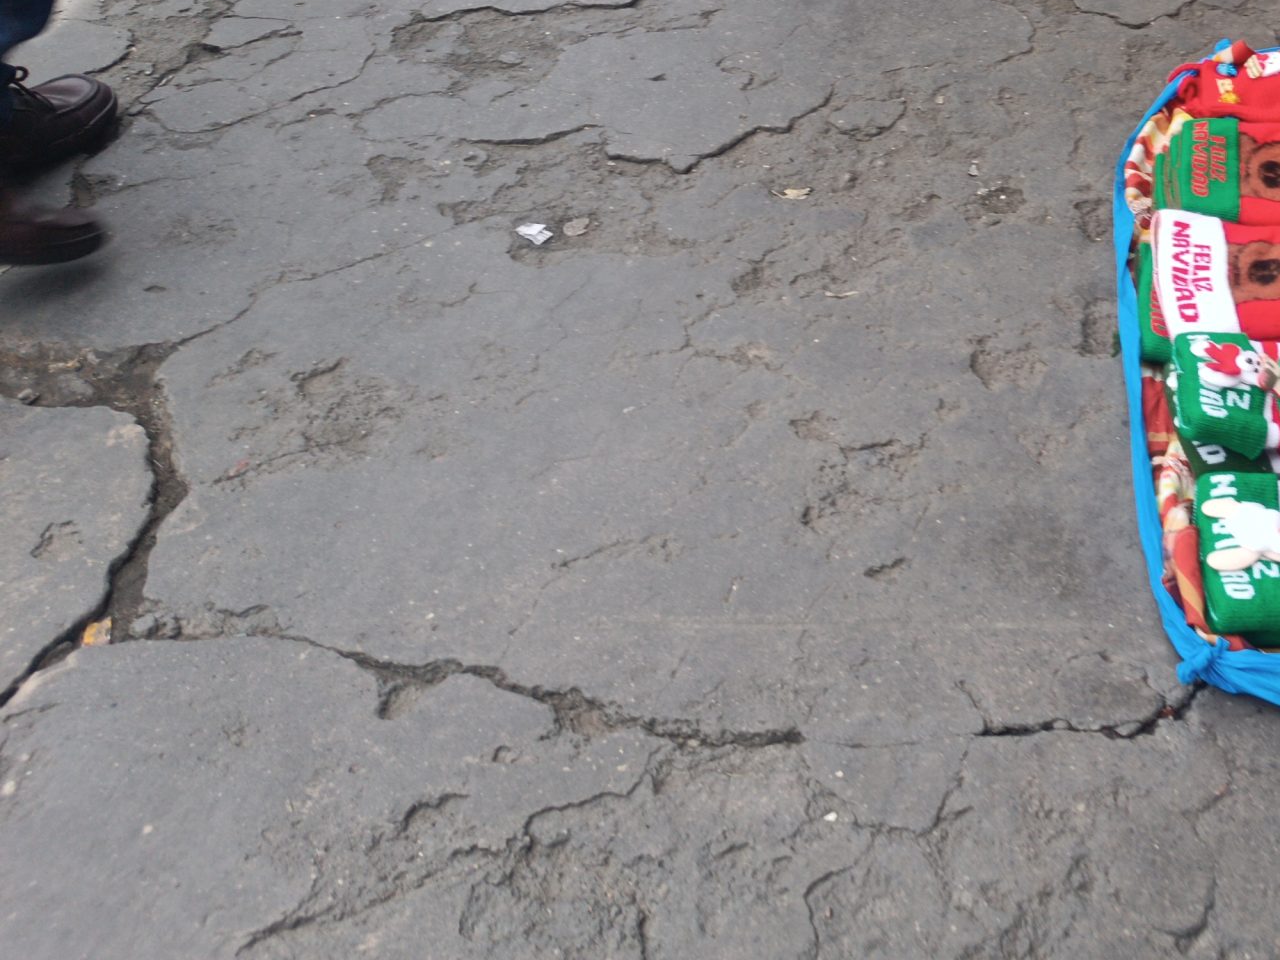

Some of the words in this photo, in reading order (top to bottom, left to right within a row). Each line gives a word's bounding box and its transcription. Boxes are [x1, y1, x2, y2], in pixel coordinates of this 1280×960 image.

[1190, 120, 1211, 197] NAVIDAD
[1208, 134, 1228, 184] FELIZ
[1171, 220, 1200, 324] NAVIDAD
[1191, 243, 1213, 293] FELIZ
